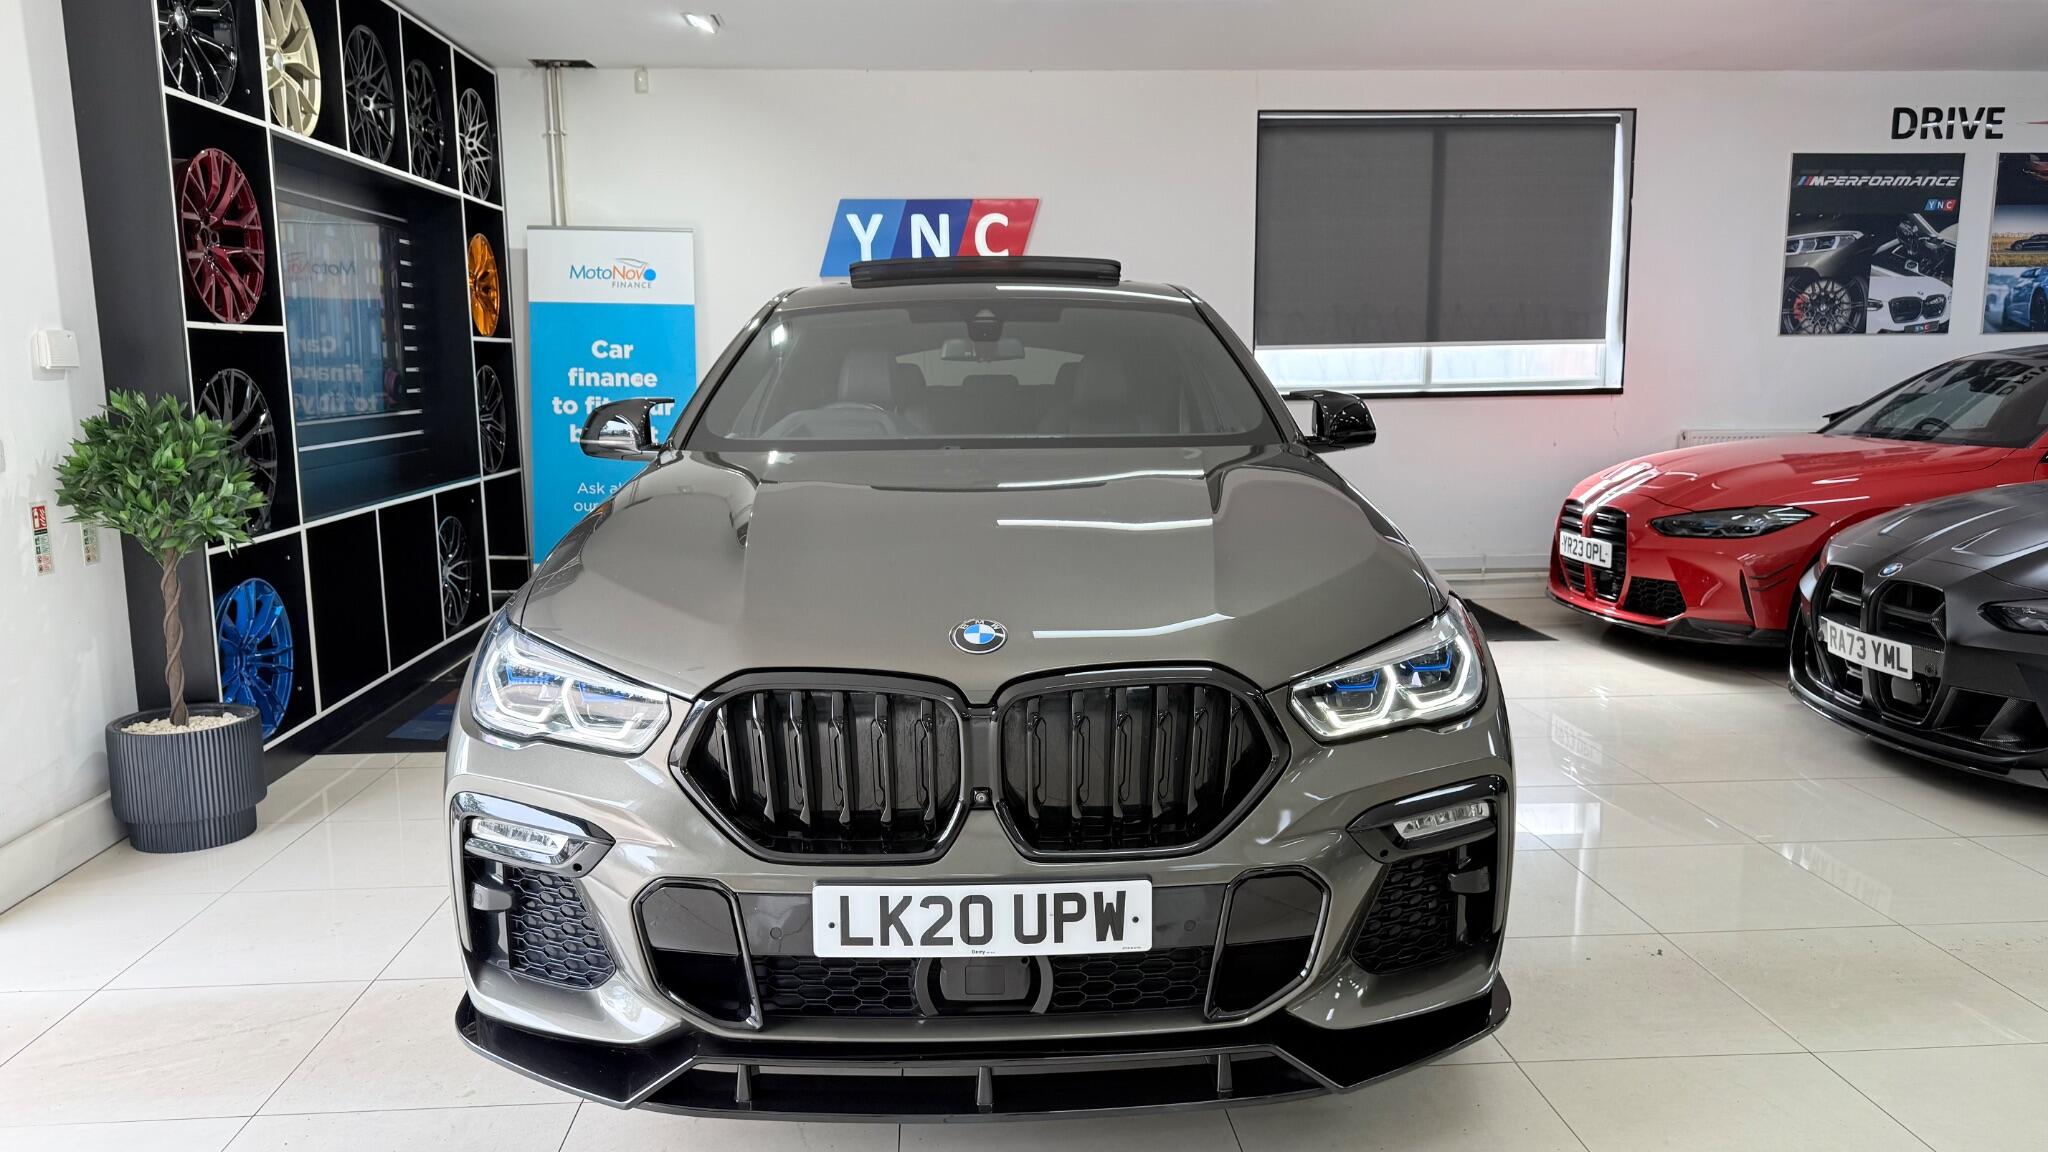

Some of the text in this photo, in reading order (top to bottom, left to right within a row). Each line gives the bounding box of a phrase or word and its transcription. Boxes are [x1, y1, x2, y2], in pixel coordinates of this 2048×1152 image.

[1891, 106, 2005, 140] DRIVE
[1928, 201, 1953, 210] YNC
[846, 213, 1009, 261] YNC
[611, 281, 652, 289] FINANCE
[591, 339, 634, 359] Car
[567, 367, 658, 388] finance
[551, 396, 578, 415] to
[650, 402, 675, 416] ur
[577, 482, 605, 494] Ask
[1563, 535, 1606, 563] YR23 OPL
[1829, 625, 1908, 673] RA73 YML
[839, 890, 1127, 947] LK20 UPW
